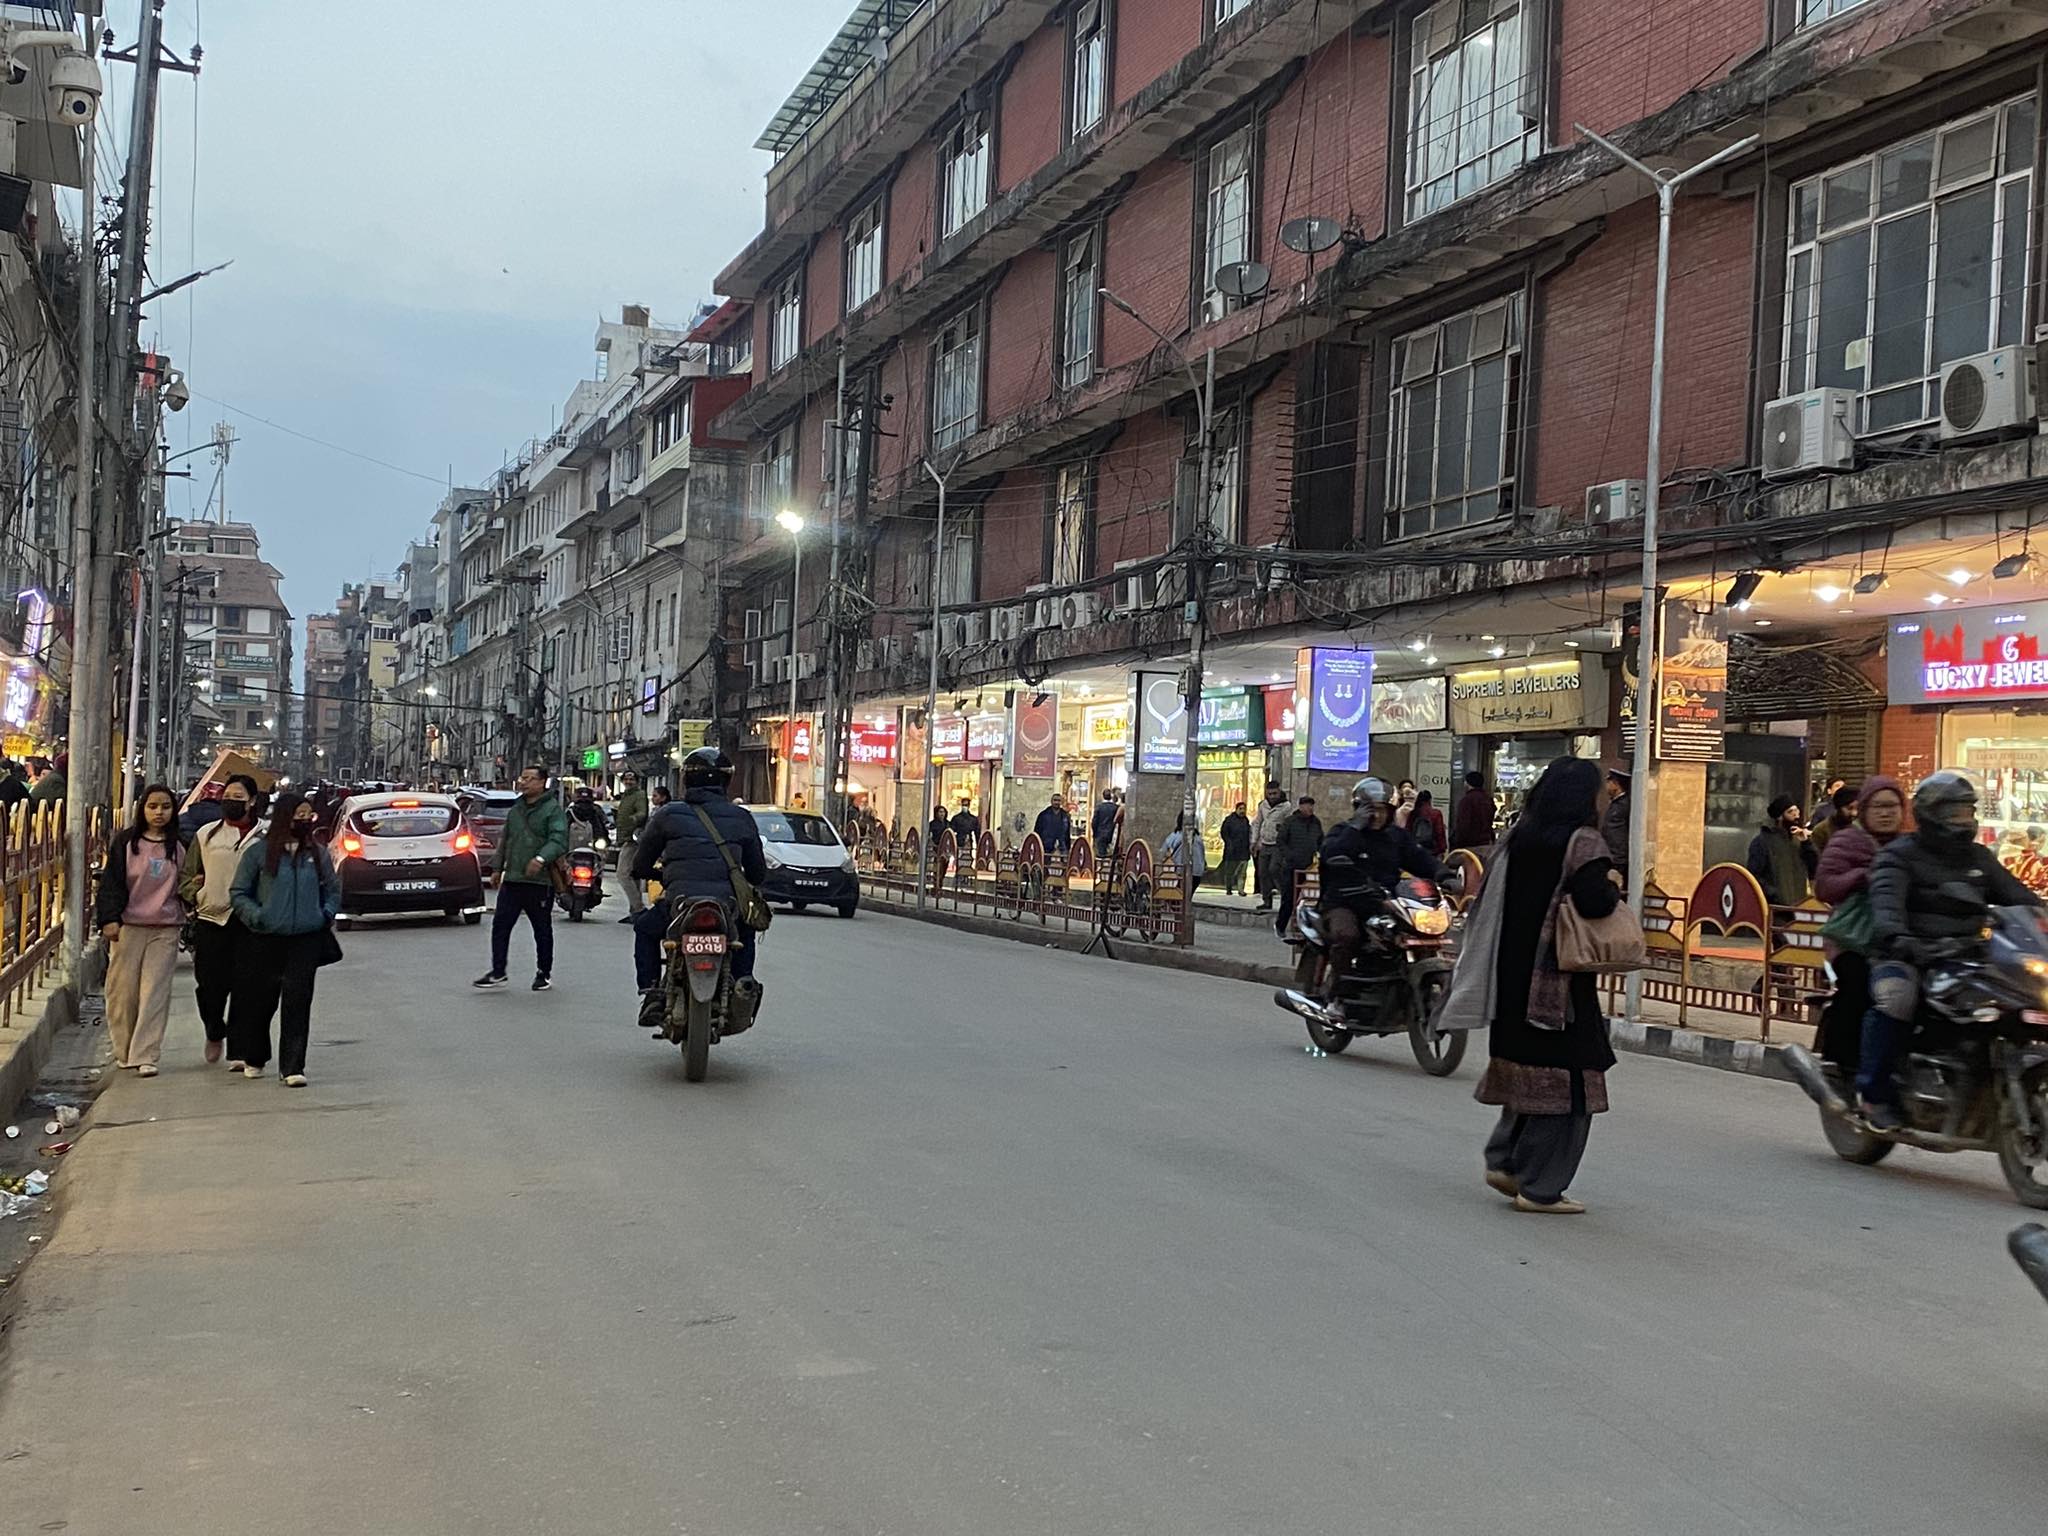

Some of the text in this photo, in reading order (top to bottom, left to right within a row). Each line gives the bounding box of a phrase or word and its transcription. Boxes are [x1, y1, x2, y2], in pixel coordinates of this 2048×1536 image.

[1452, 673, 1581, 700] SUPREME JEWELLERS
[1925, 664, 1987, 691] LUCKY
[1144, 742, 1185, 755] Diamond
[1431, 776, 1450, 785] GIA
